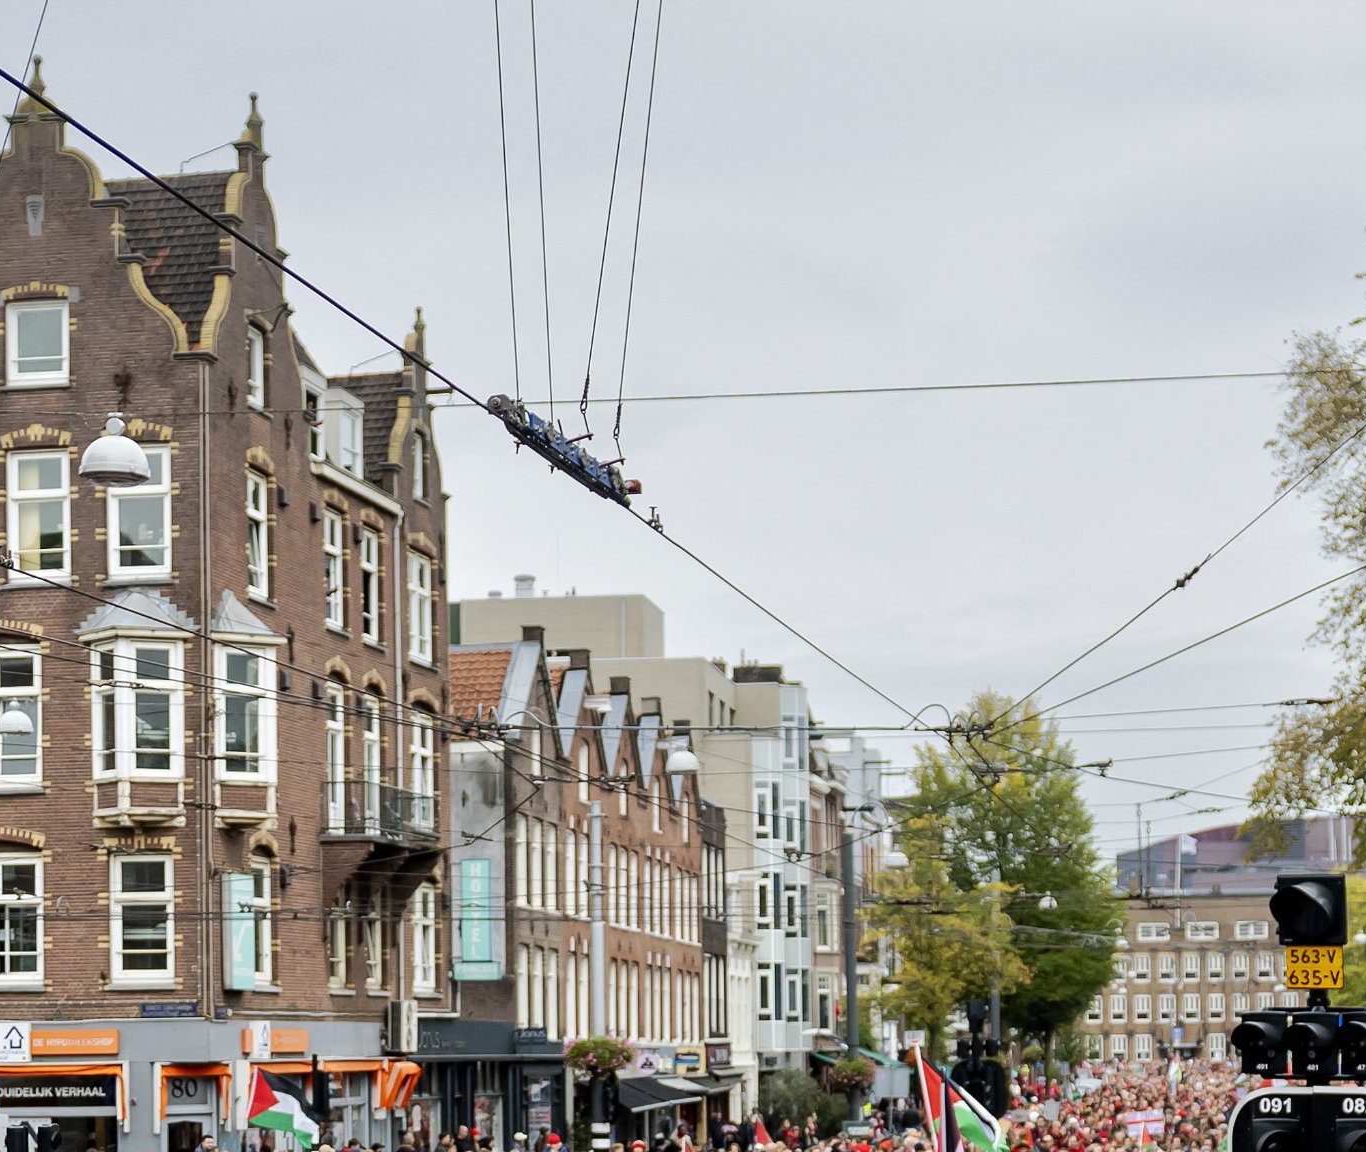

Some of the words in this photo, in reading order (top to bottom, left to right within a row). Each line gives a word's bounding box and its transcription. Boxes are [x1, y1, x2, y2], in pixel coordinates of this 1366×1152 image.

[1290, 949, 1336, 964] 563-V
[1289, 970, 1340, 986] 635-V
[55, 1086, 106, 1097] VERHAAL
[171, 1078, 197, 1098] 80
[1259, 1098, 1292, 1113] 091
